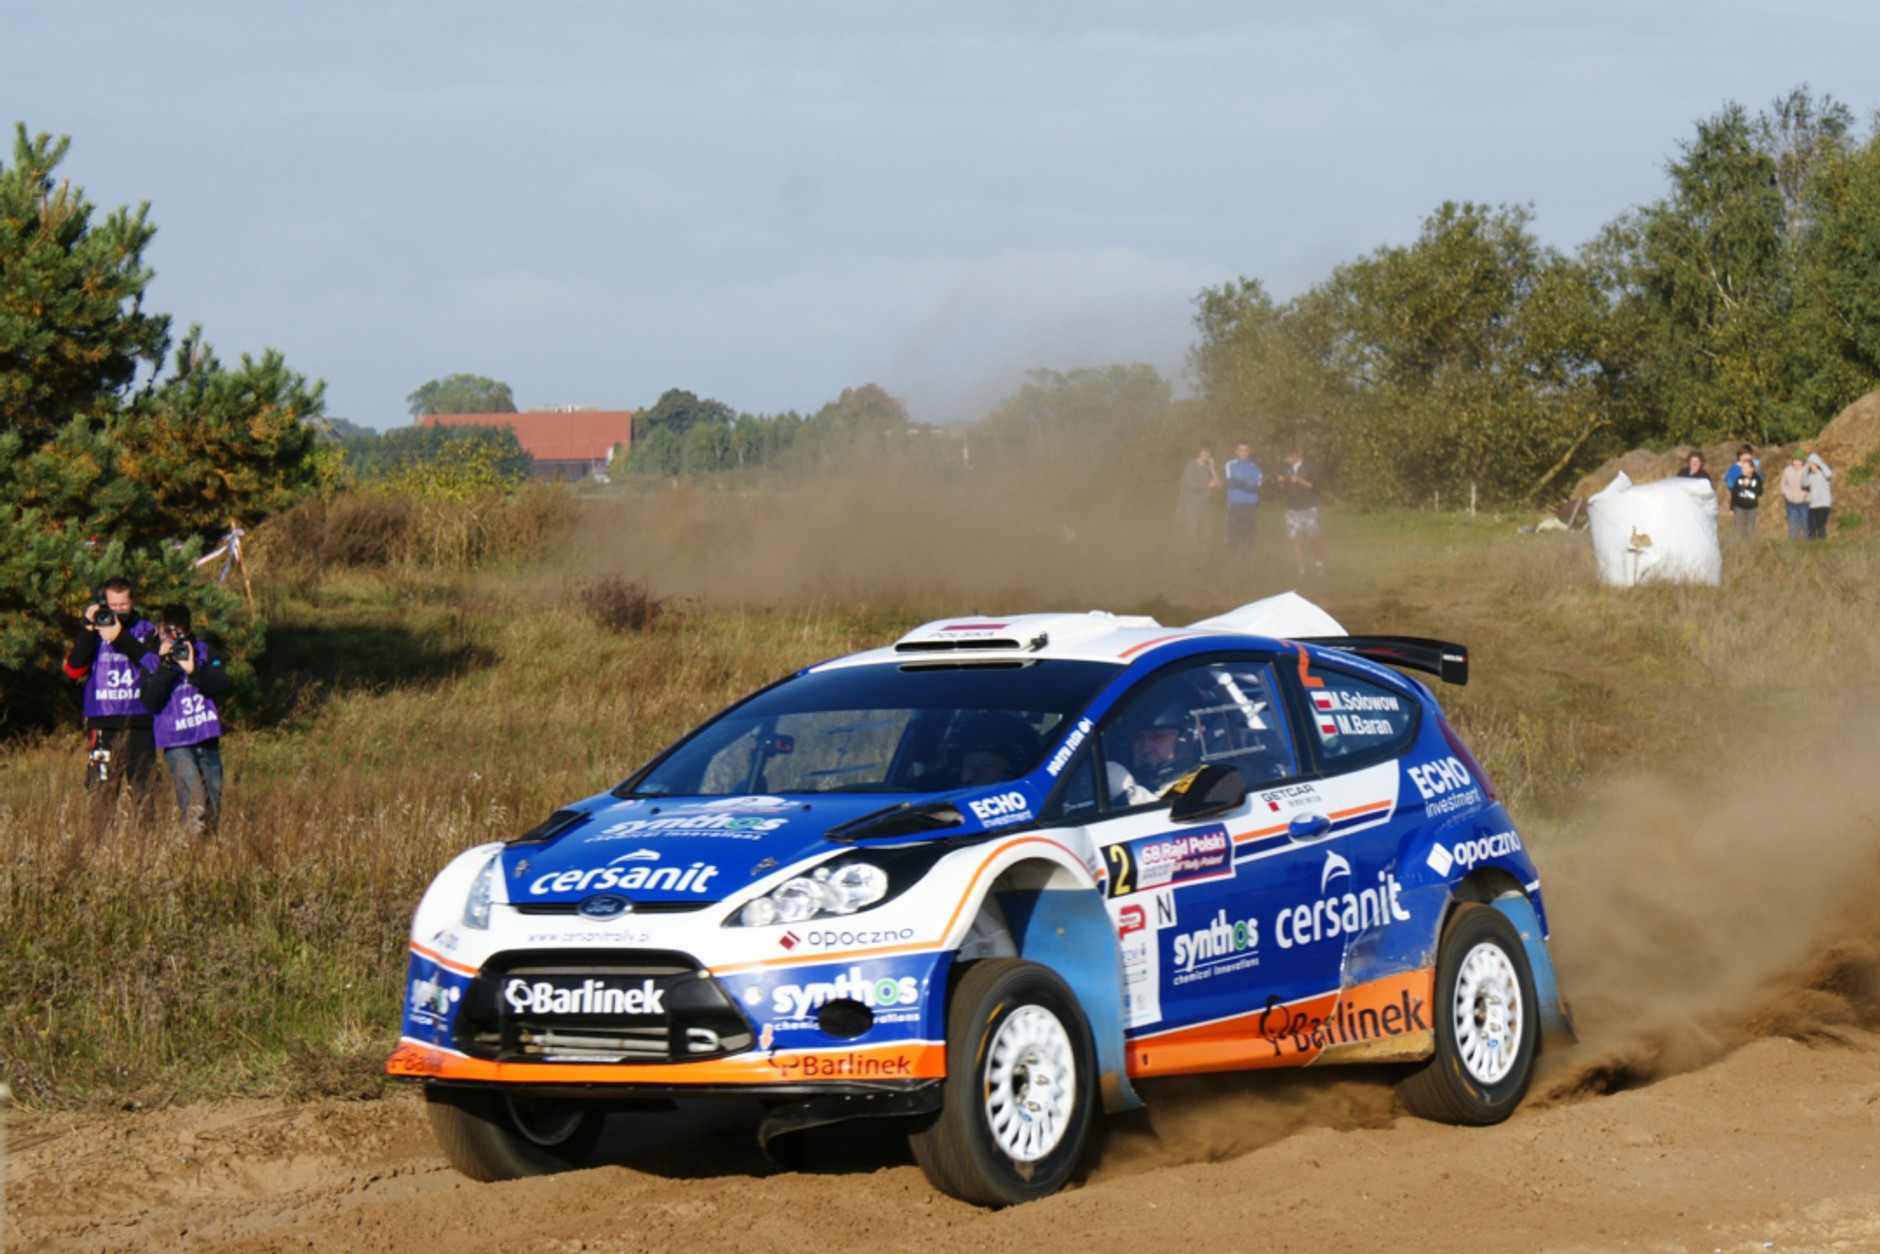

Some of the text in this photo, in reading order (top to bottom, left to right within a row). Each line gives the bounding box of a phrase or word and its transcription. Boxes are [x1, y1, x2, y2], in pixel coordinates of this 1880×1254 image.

[107, 668, 134, 688] 34
[175, 709, 218, 731] MEDIA
[180, 693, 206, 716] 32
[1336, 714, 1394, 735] M.Baran
[1260, 784, 1316, 803] GETCAR
[1406, 756, 1472, 800] ECHO
[968, 792, 1027, 819] ECHO
[1425, 786, 1482, 818] investment
[602, 813, 790, 836] synthos
[1142, 830, 1226, 865] 68 Rajd Polski
[1453, 830, 1522, 870] opoczno
[529, 861, 720, 895] cersanit
[1109, 843, 1131, 896] 2
[1156, 892, 1173, 925] N
[1275, 870, 1411, 949] cersanit
[808, 928, 915, 950] opoczno
[1173, 909, 1260, 973] synthos
[1173, 966, 1212, 986] chemical
[531, 979, 665, 1015] Barlinek
[772, 966, 919, 1021] synthos
[1290, 990, 1427, 1053] Barlinek
[803, 1053, 912, 1078] Barlinek
